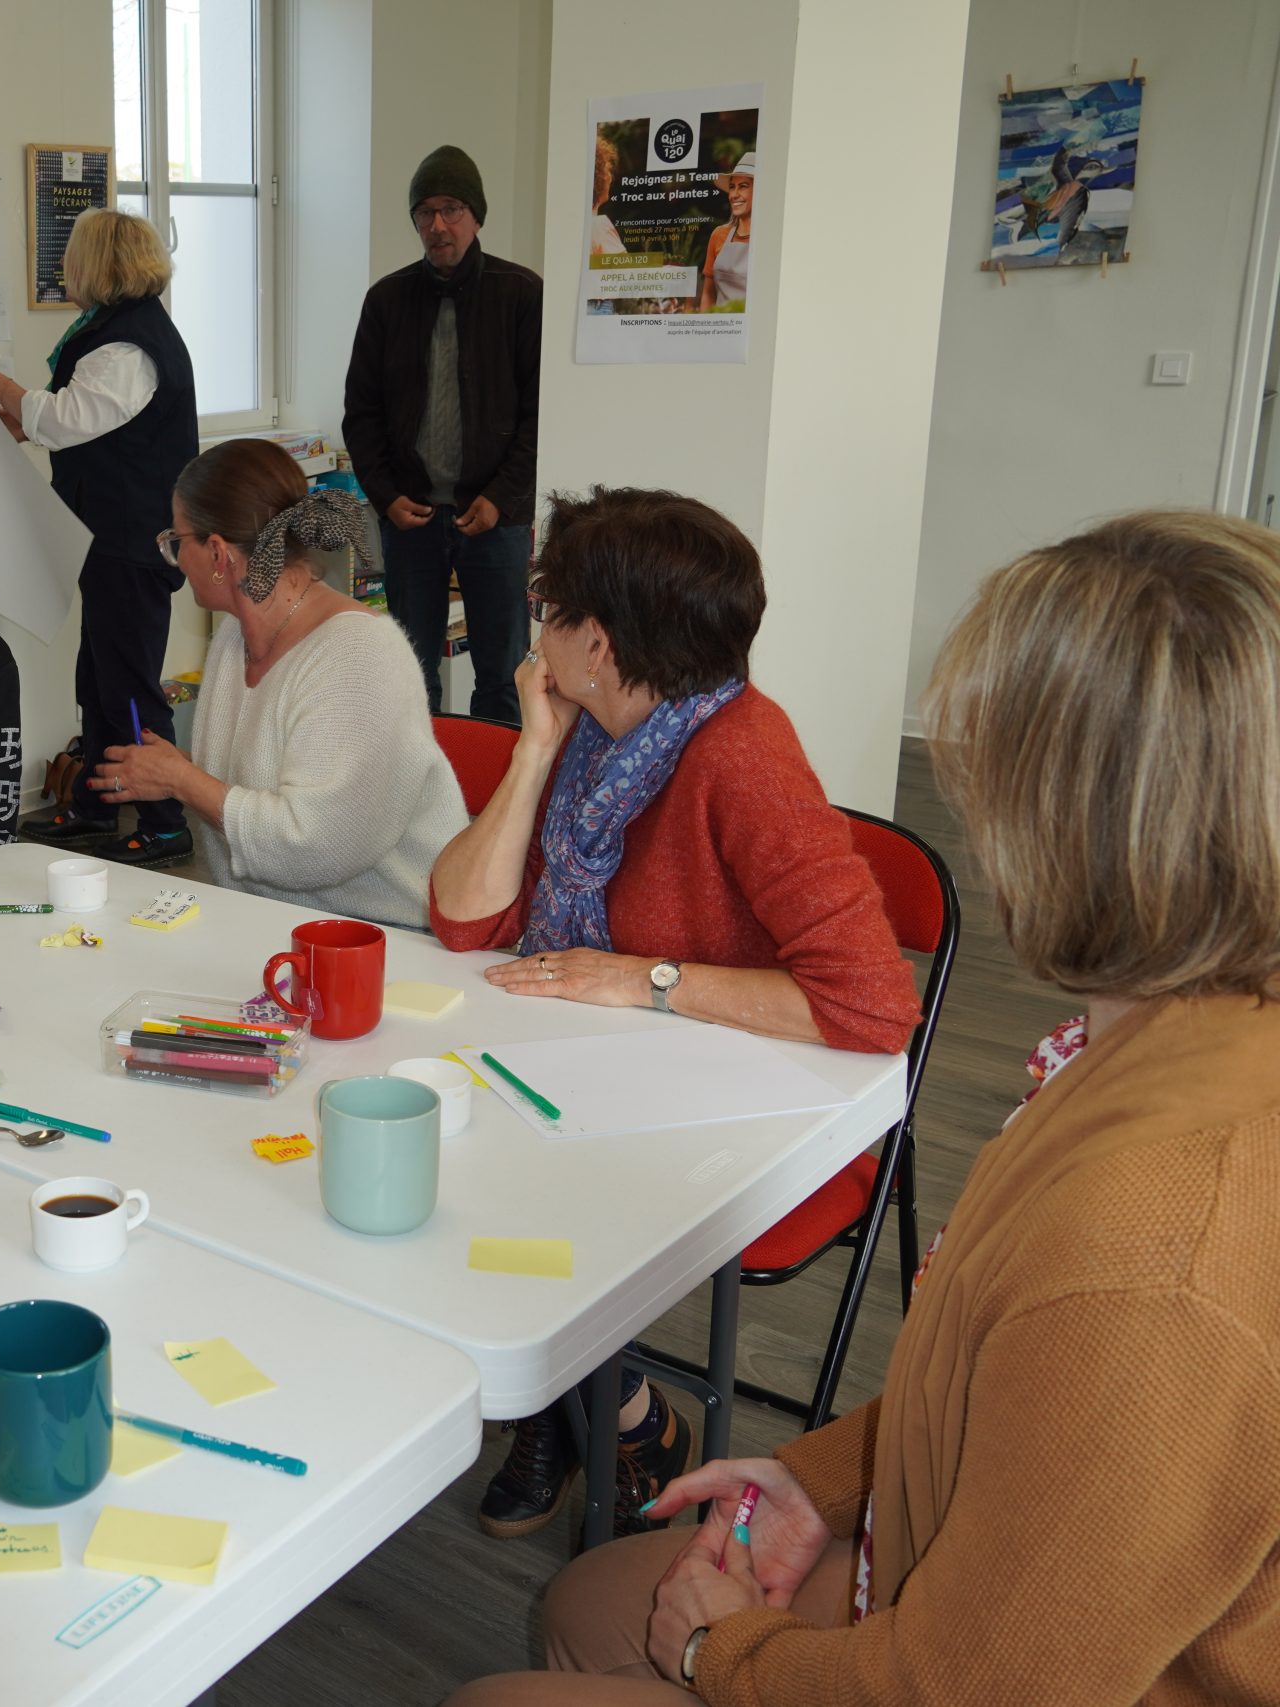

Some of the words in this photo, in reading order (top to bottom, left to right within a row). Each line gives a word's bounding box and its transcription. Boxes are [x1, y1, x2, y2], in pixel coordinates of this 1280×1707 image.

[661, 133, 686, 146] Quai
[664, 146, 684, 159] 120
[621, 174, 673, 188] Rejoignez
[675, 173, 686, 183] la
[688, 171, 719, 182] Team
[53, 187, 93, 197] PAYSAGES
[620, 192, 644, 202] Troc
[646, 191, 665, 201] aux
[668, 188, 709, 202] plantes
[53, 197, 93, 208] D'ÉCRANS
[620, 218, 655, 227] rencontres
[656, 217, 673, 227] pour
[624, 226, 654, 235] Vendredi
[664, 225, 681, 233] mars
[688, 223, 700, 232] 19h
[601, 256, 611, 265] LE
[612, 256, 633, 265] QUAI
[634, 255, 649, 264] 120
[600, 273, 628, 283] APPEL
[637, 271, 688, 282] BÉNÉVOLES
[618, 285, 633, 293] AUX
[366, 582, 384, 592] Bingo
